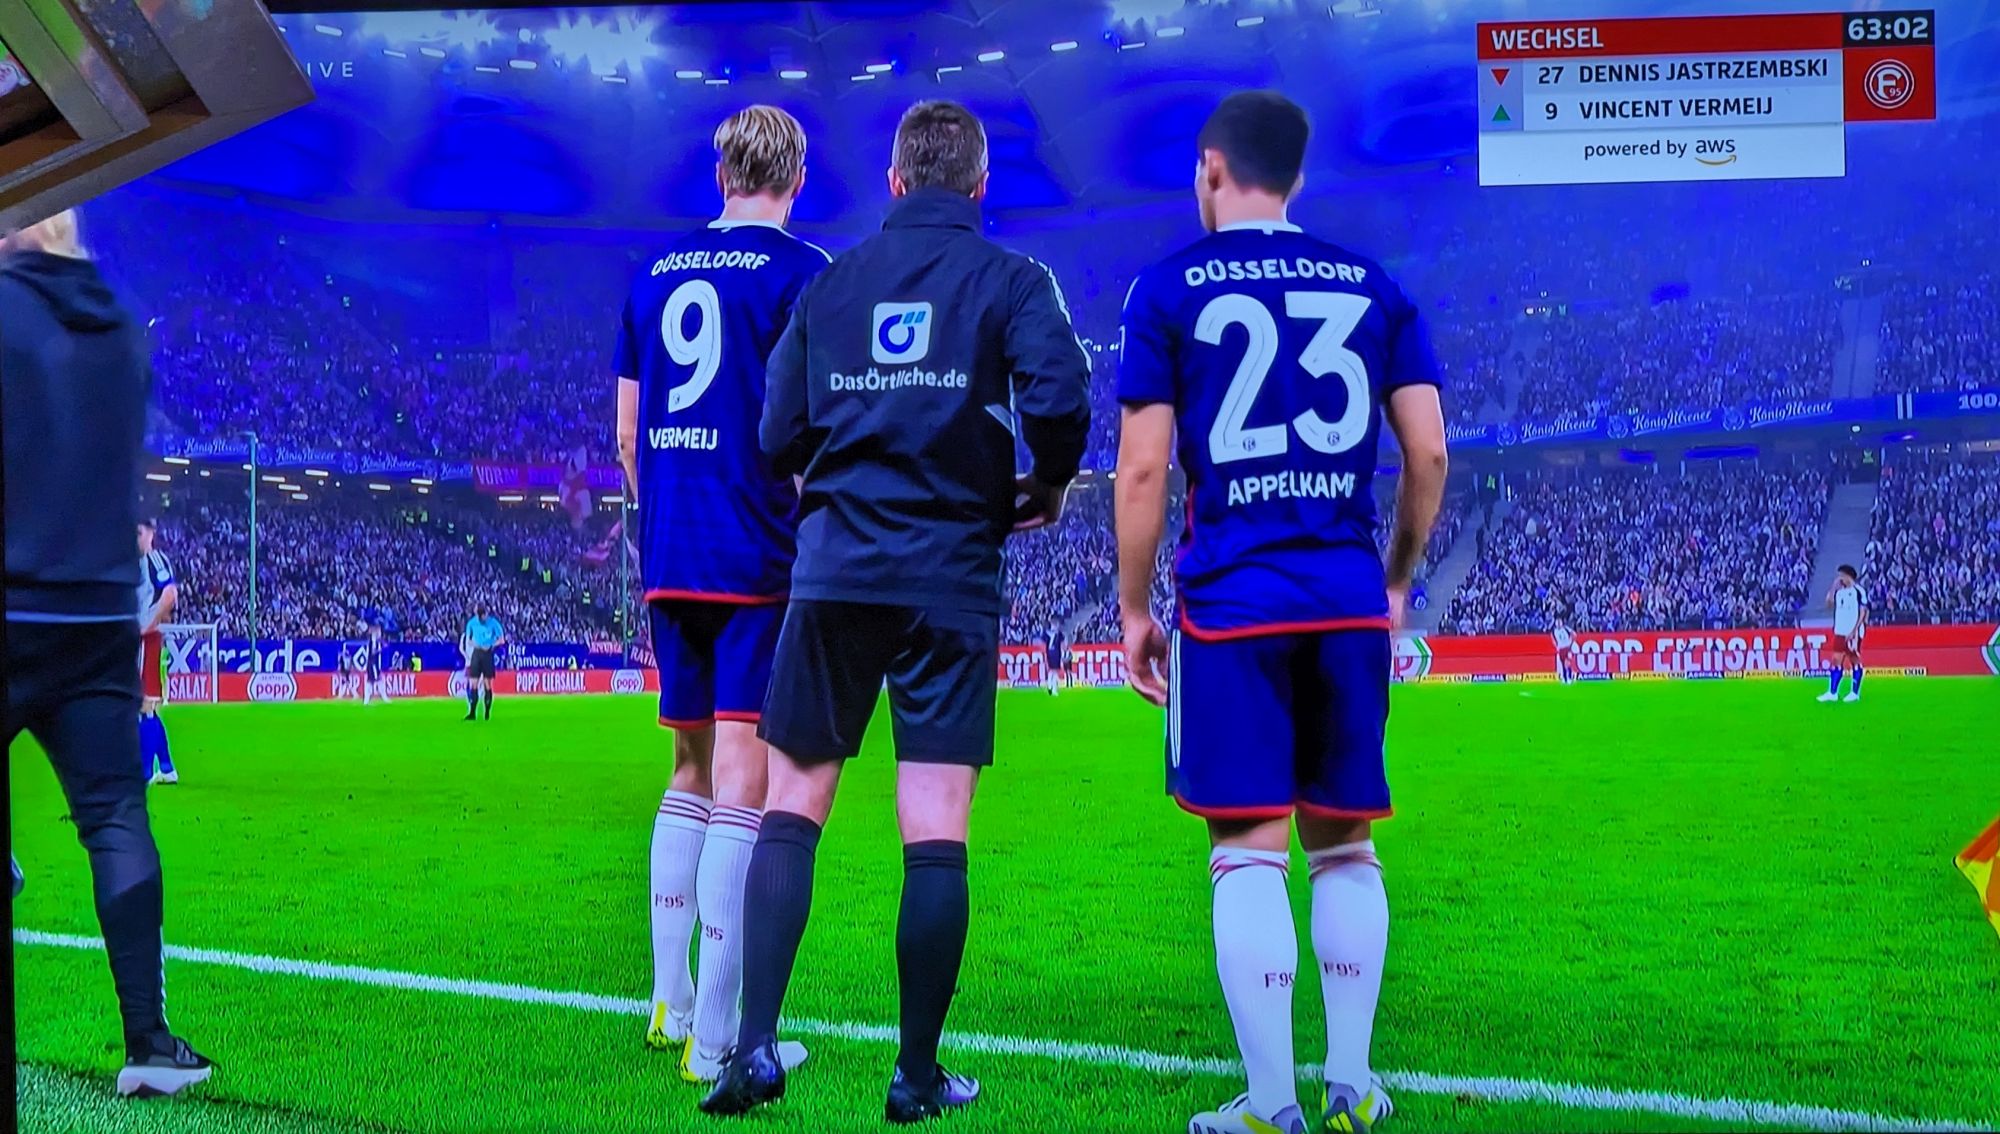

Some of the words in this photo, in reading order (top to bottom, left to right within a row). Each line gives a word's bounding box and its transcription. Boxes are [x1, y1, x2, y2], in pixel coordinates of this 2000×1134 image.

[1491, 27, 1604, 50] WECHSEL
[1848, 17, 1928, 40] 63:02
[306, 61, 353, 78] IVE
[1538, 66, 1564, 84] 27
[1579, 63, 1660, 83] DENNIS
[1666, 58, 1828, 81] JASTRZEMBSKI
[1545, 103, 1558, 121] 9
[1579, 100, 1672, 120] VINCENT
[1679, 96, 1773, 117] VERMEIJ
[1584, 140, 1660, 159] powered
[1667, 139, 1688, 158] by
[1695, 138, 1736, 154] aws
[651, 250, 770, 277] DÜSSELDORF
[1185, 257, 1367, 287] DÜSSELDORF
[661, 279, 722, 414] 9
[1194, 291, 1372, 464] 23
[1958, 392, 2000, 410] 100
[649, 427, 719, 450] VERMEIJ
[512, 655, 566, 670] amburger
[256, 683, 290, 699] popp
[516, 672, 539, 692] POPP
[616, 679, 639, 691] popp
